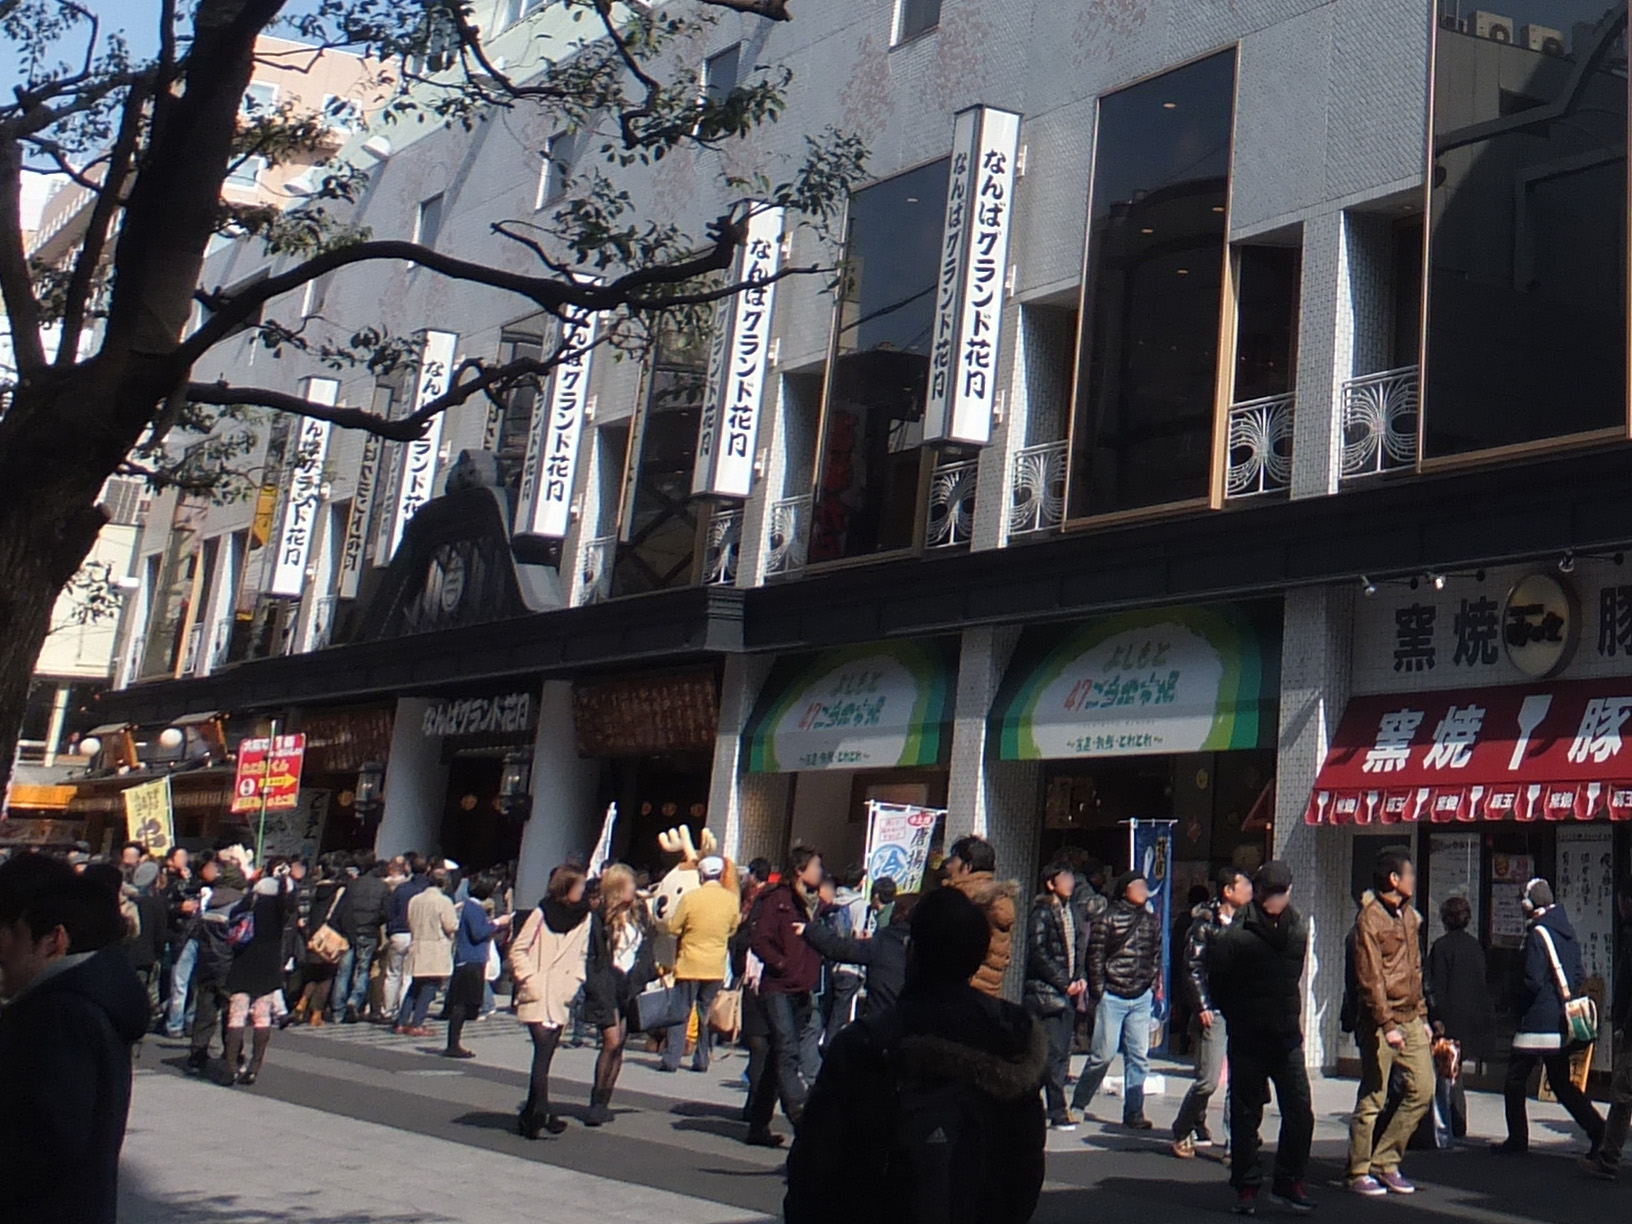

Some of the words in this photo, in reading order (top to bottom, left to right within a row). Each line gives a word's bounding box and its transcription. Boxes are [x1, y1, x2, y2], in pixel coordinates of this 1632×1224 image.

[932, 152, 968, 401] なんばグランド花月
[965, 149, 1007, 399] なんばグランド花月
[1362, 704, 1487, 773] 窯焼
